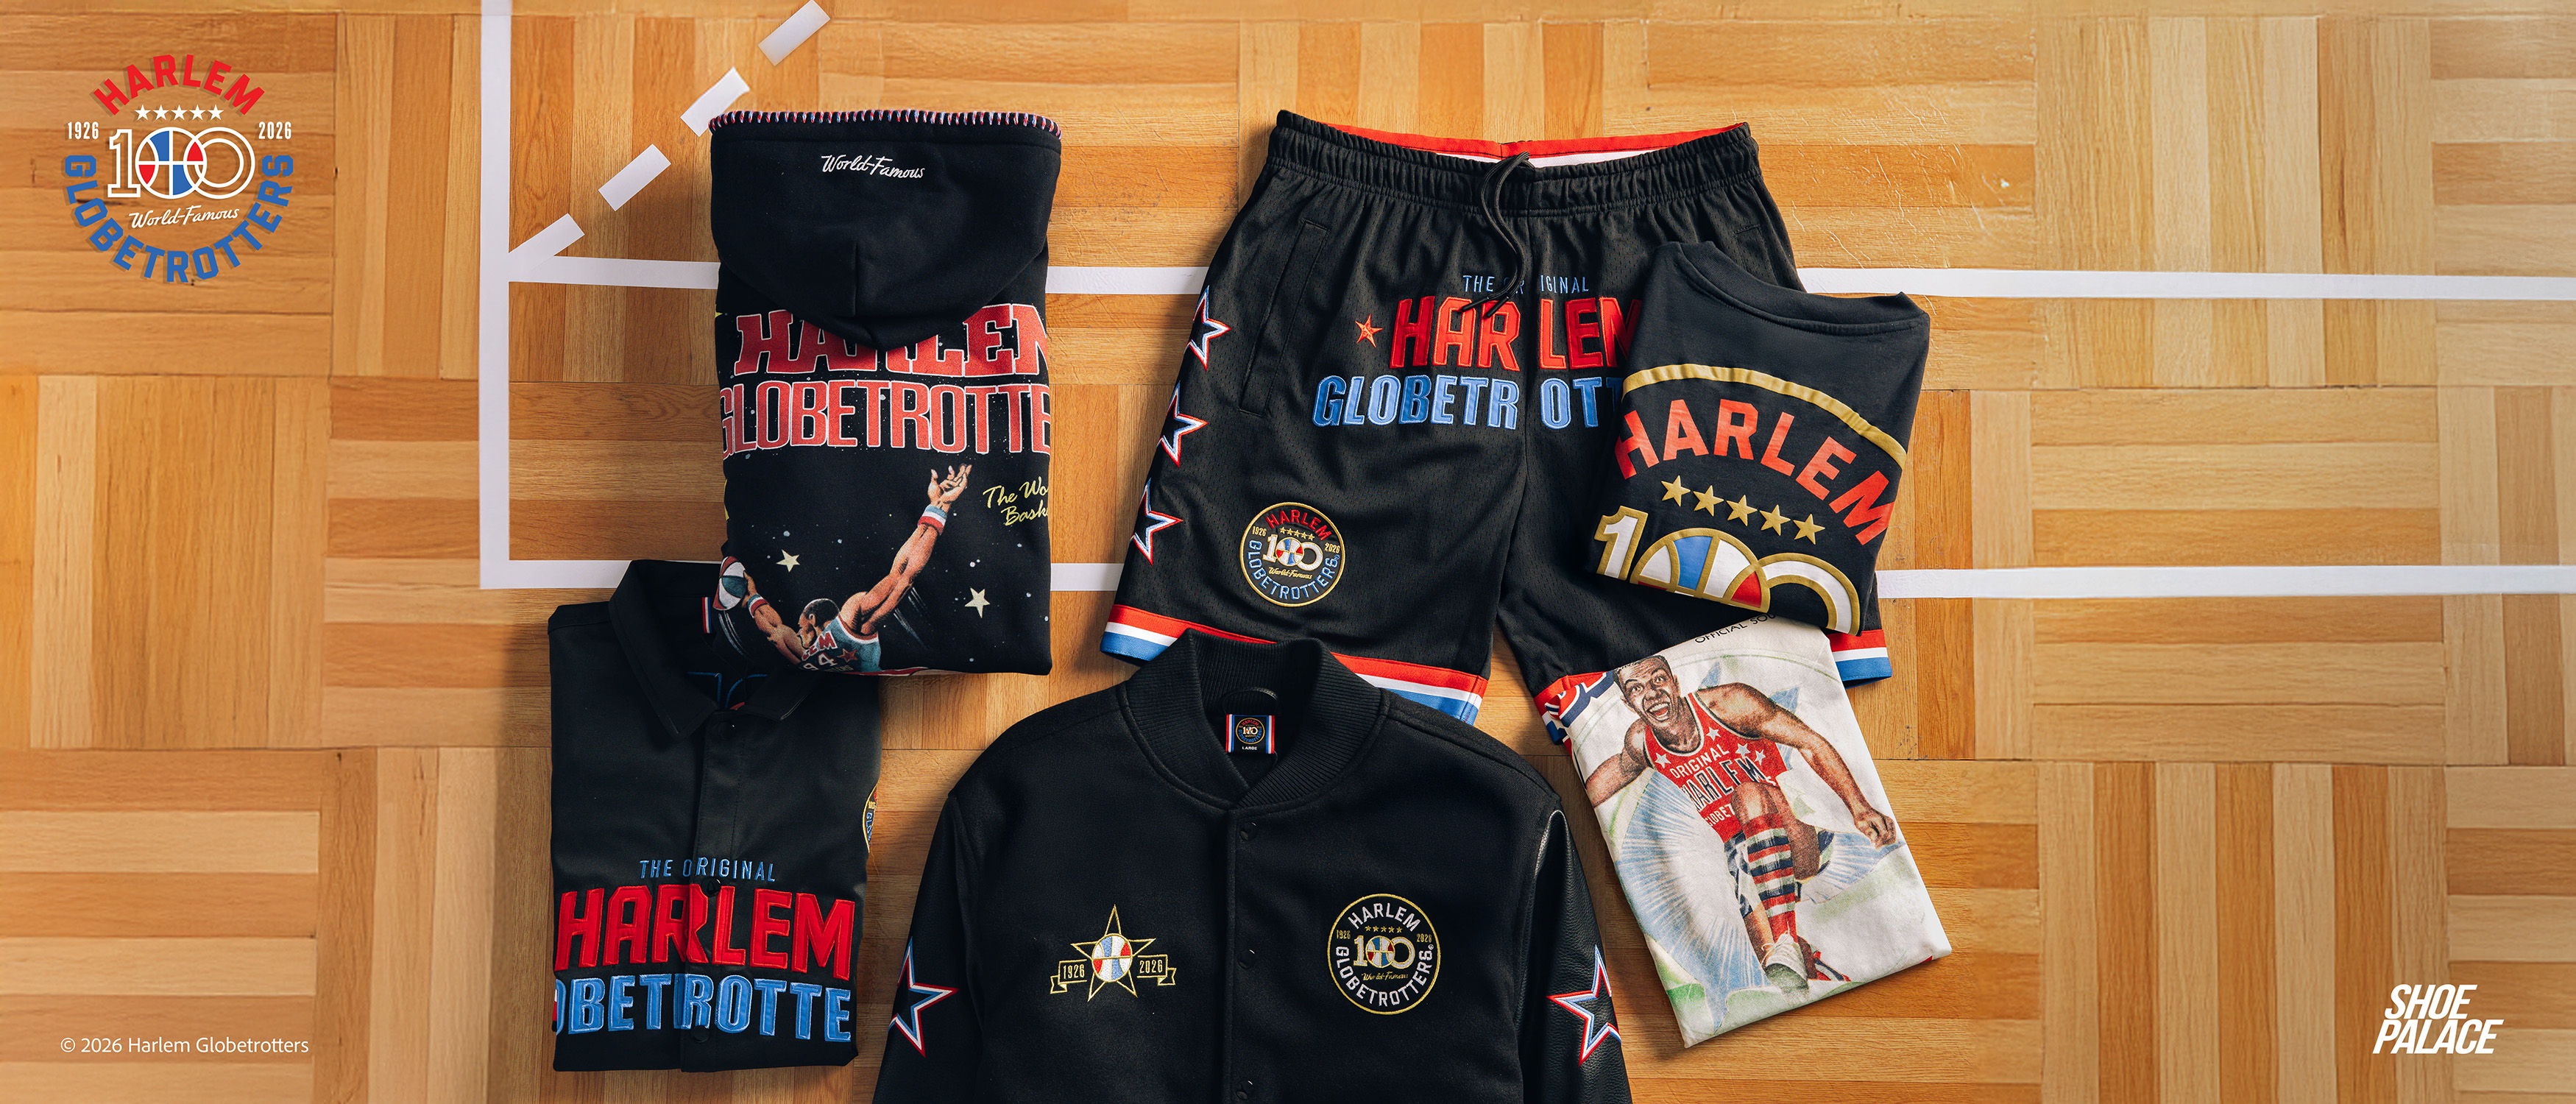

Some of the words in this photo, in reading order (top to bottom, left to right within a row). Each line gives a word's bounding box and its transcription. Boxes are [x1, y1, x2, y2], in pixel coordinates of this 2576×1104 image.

[821, 155, 925, 179] World-Famous
[1462, 275, 1495, 293] THE
[1615, 398, 1895, 546] HARLEM
[983, 485, 1018, 509] The
[1252, 526, 1267, 537] 1926
[1265, 509, 1332, 541] HARLEM
[1325, 542, 1340, 553] 2026
[1669, 744, 1730, 779] ORIGINAL
[640, 859, 673, 879] THE
[682, 857, 776, 882] ORIGINAL
[1348, 902, 1421, 932] HARLEM
[555, 883, 856, 981] HARLEM
[1336, 930, 1351, 940] 1926
[1063, 963, 1086, 980] 1926
[1139, 959, 1163, 974] 2026
